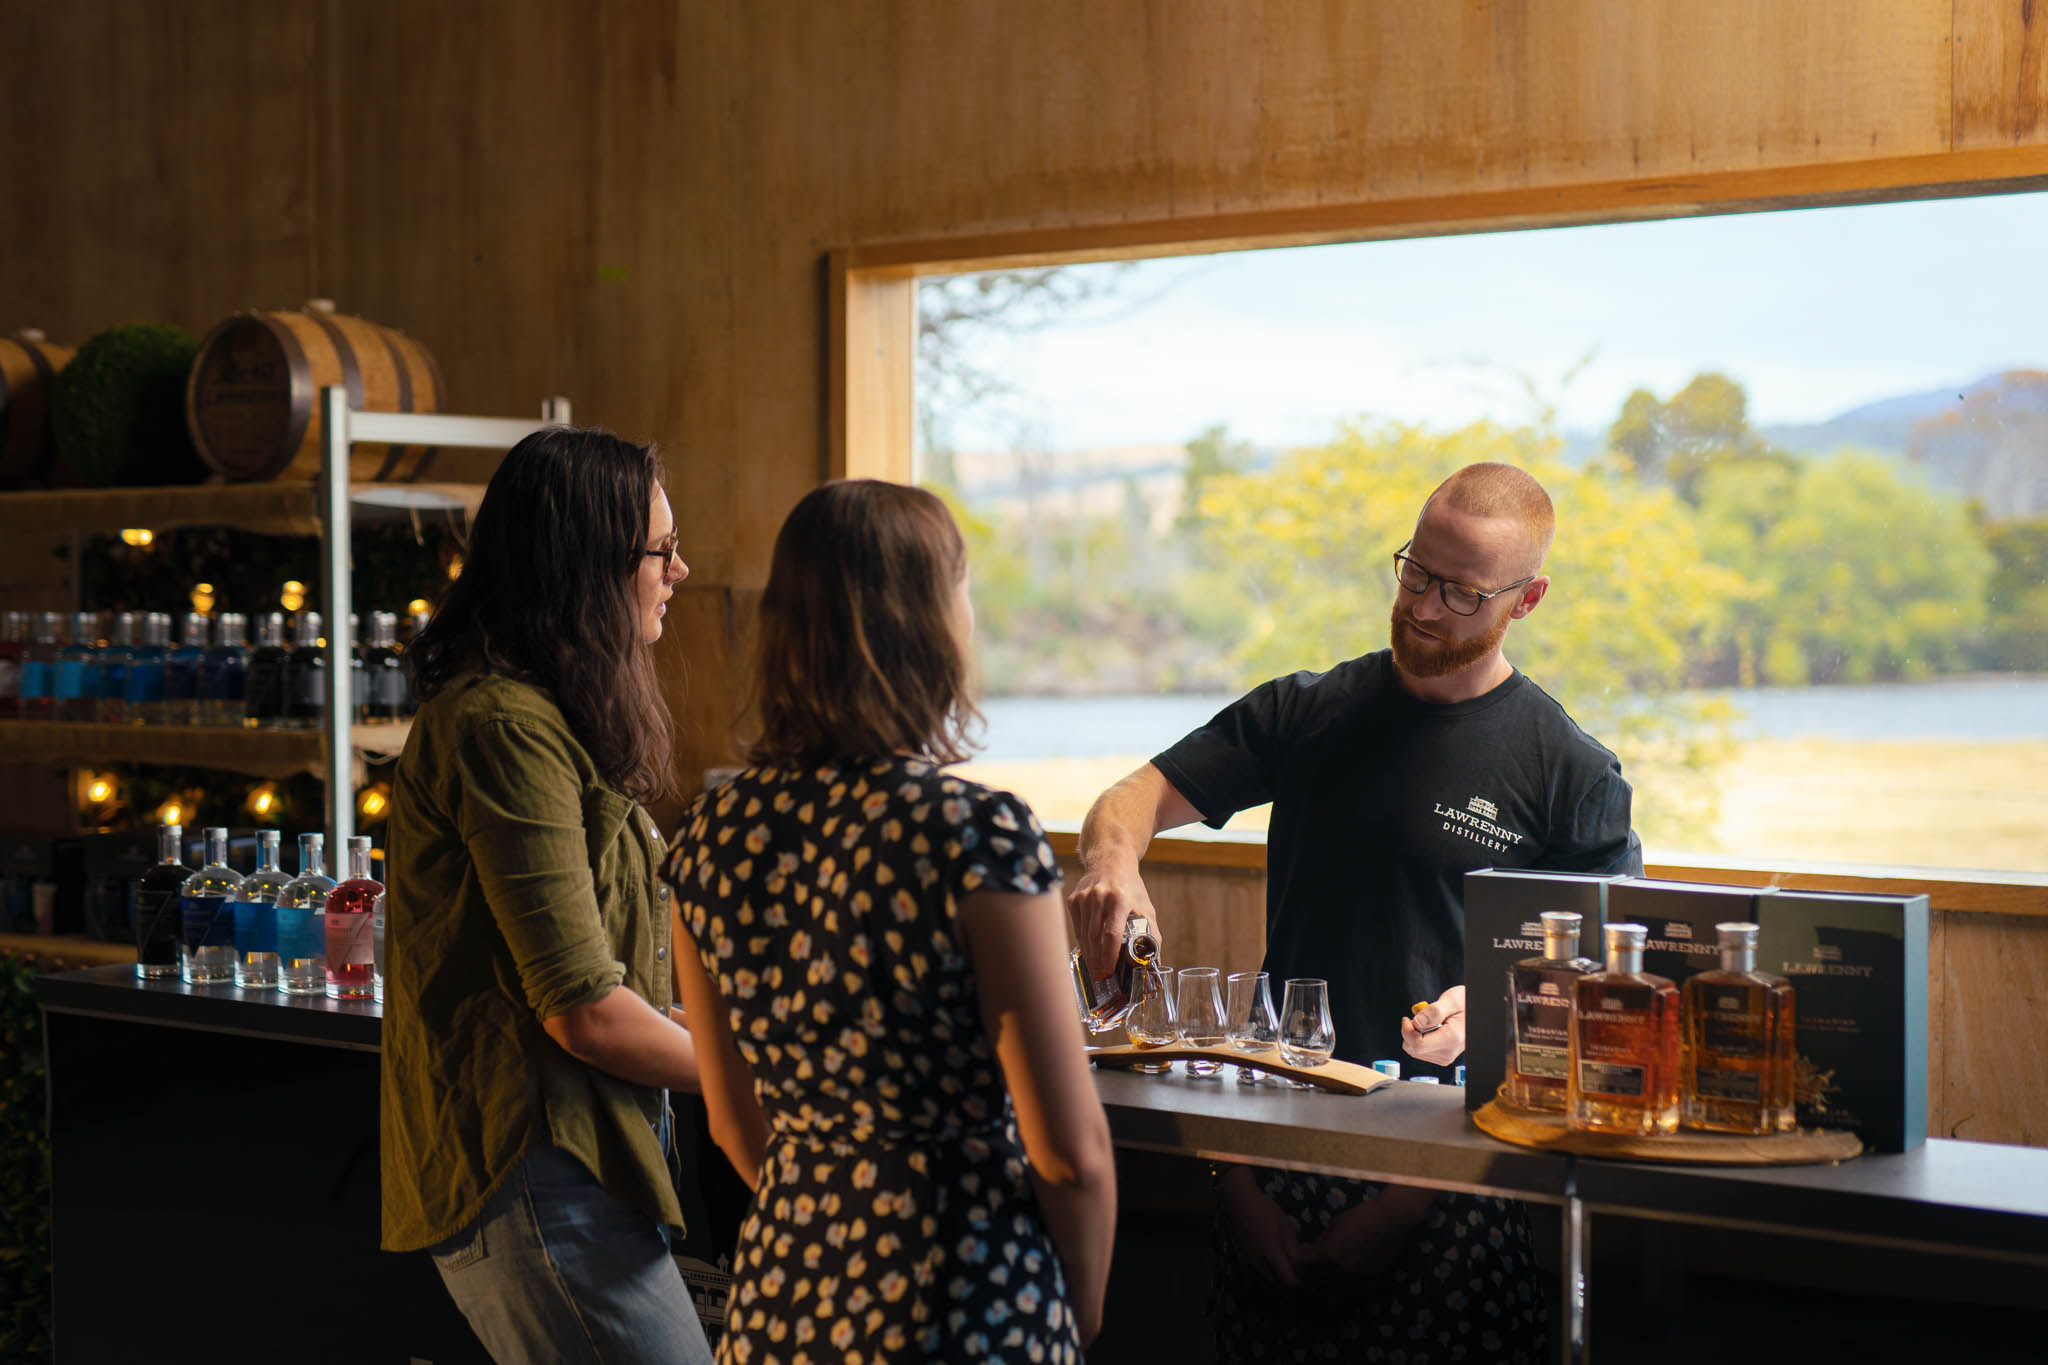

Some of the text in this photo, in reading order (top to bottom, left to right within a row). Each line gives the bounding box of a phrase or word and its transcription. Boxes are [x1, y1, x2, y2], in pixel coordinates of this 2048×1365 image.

[1434, 803, 1523, 844] LAWRENNY
[1443, 822, 1508, 852] DISTILLERY
[1493, 938, 1544, 951] LAWRE
[1646, 939, 1721, 955] AWRENNY
[1517, 993, 1570, 1007] LAWREN
